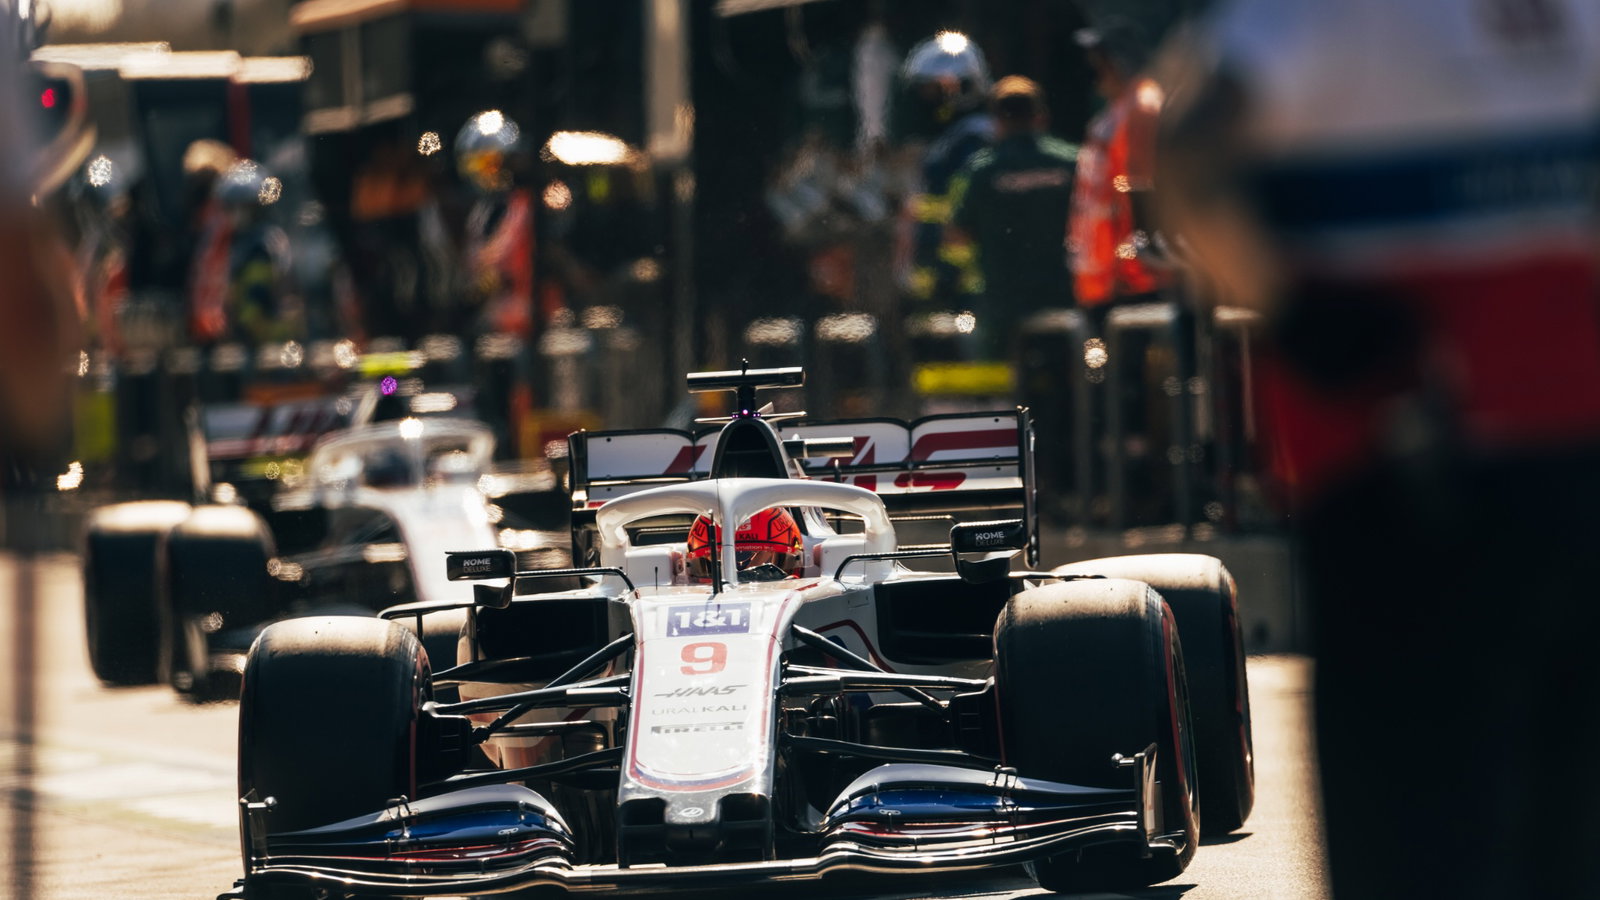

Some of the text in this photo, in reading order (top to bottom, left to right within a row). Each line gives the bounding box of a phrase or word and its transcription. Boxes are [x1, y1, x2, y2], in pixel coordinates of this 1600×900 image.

[975, 531, 1005, 540] HOME
[463, 558, 491, 567] HOME
[463, 565, 491, 574] DELUXE
[674, 609, 741, 629] 1&1
[680, 641, 728, 675] 9
[654, 684, 749, 698] HAAS
[652, 705, 747, 716] URALKALI
